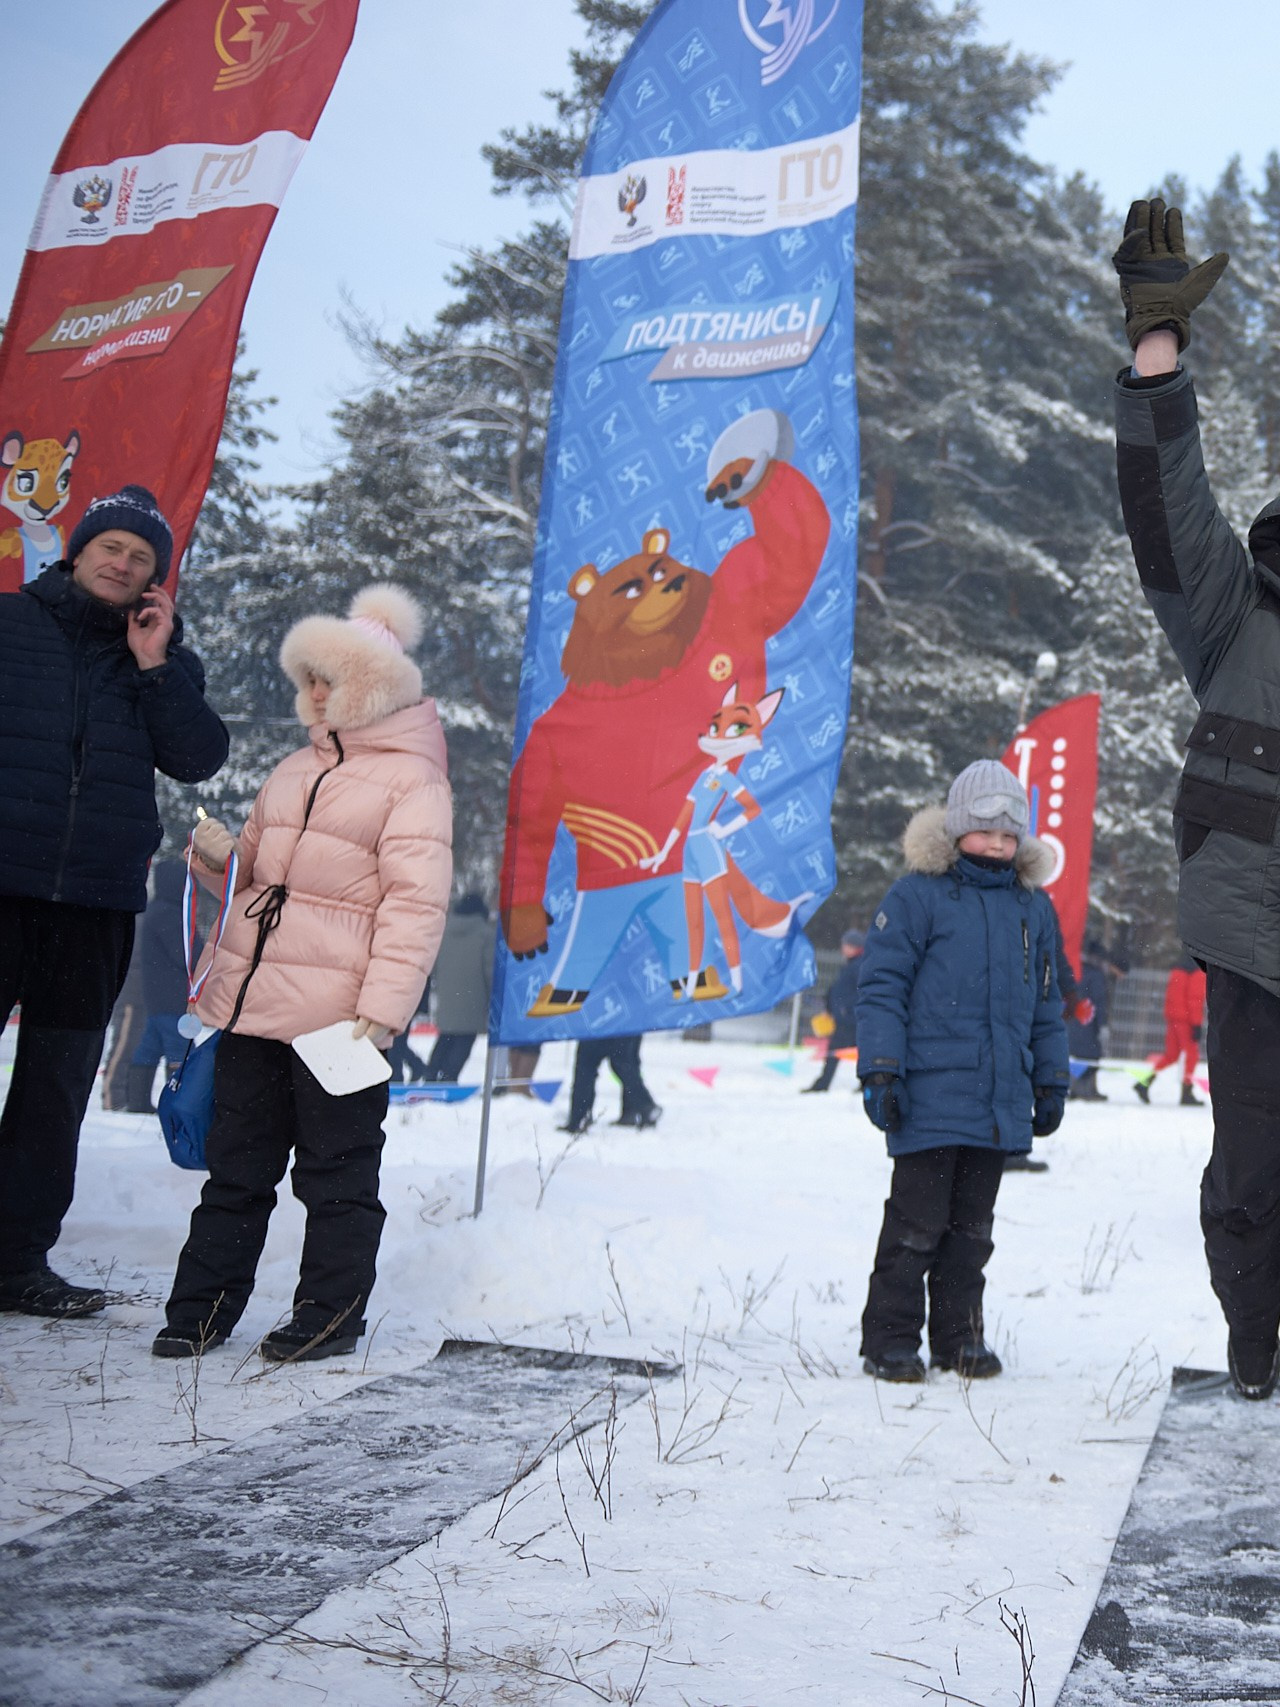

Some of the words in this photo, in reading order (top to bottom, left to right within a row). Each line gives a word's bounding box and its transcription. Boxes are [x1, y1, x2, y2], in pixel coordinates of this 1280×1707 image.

[191, 144, 258, 195] ГТО
[778, 143, 843, 202] ГТО
[672, 352, 686, 370] к
